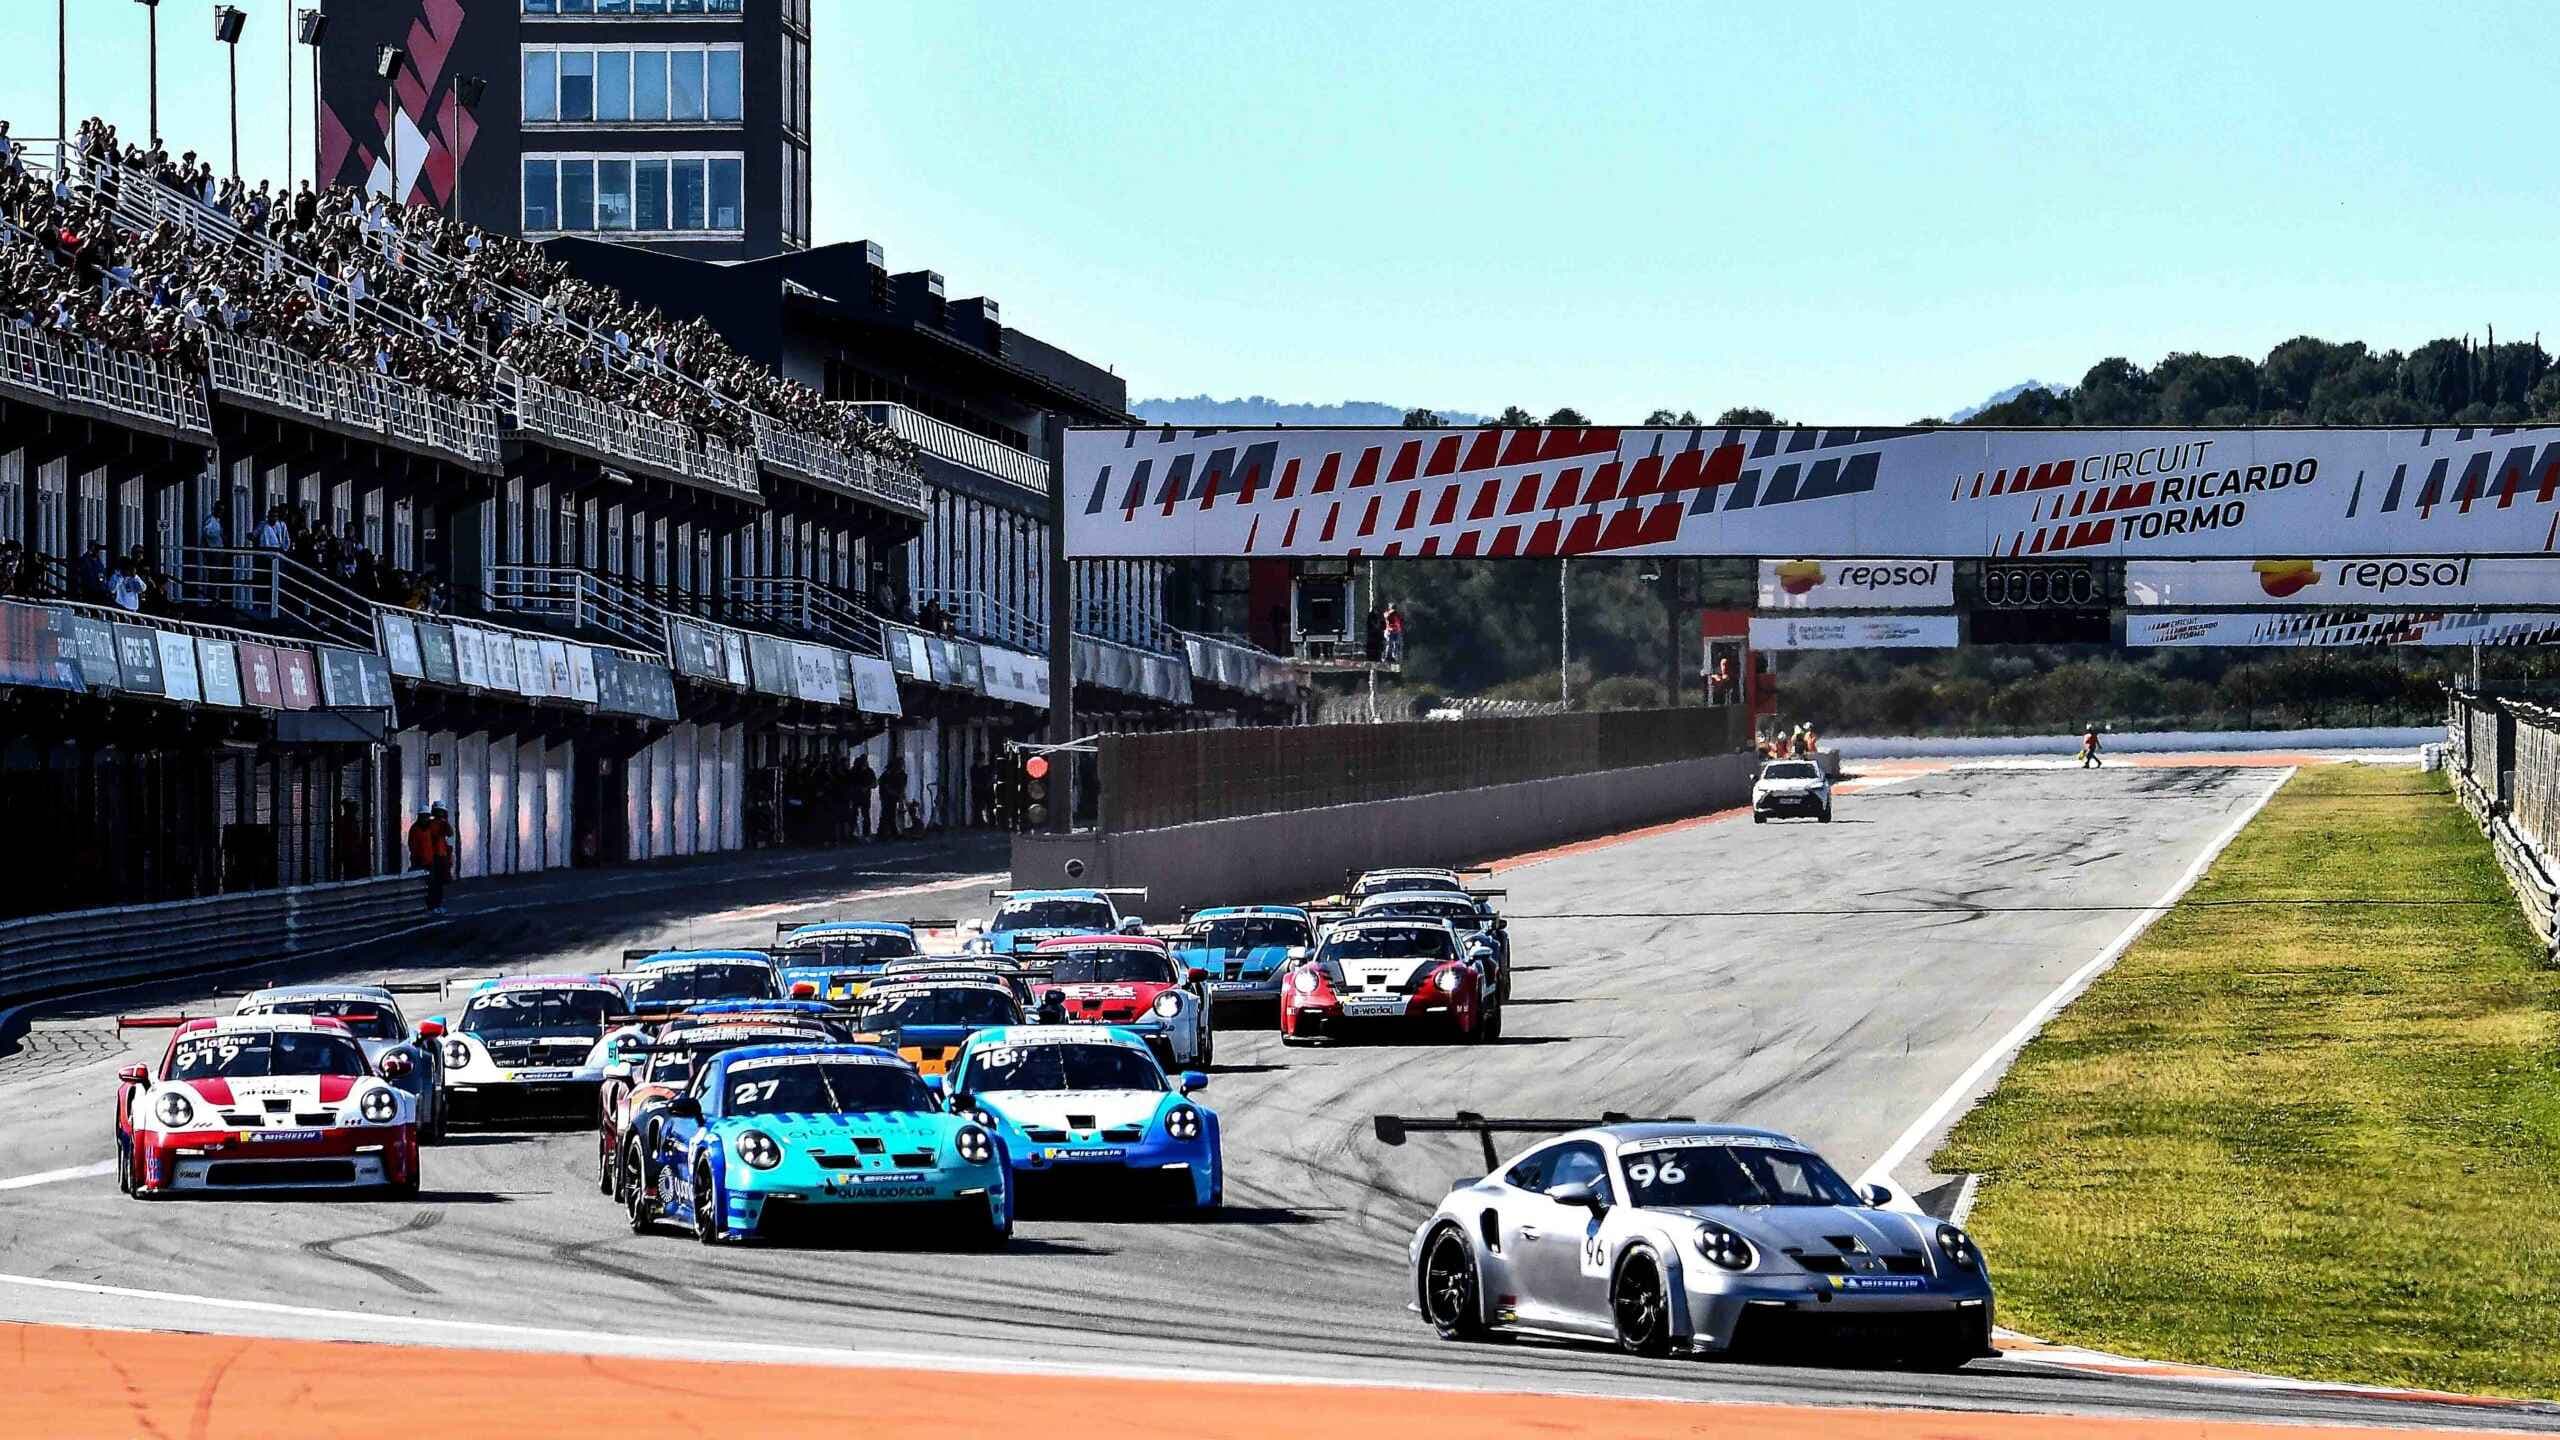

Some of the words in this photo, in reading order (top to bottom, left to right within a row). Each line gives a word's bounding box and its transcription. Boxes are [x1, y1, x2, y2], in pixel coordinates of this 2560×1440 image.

[2081, 441, 2213, 483] CIRCUIT
[2160, 457, 2319, 505] RICARDO
[2120, 500, 2246, 542] TORMO
[1839, 562, 1938, 591] repsol
[2338, 557, 2471, 593] repsol
[2171, 617, 2198, 627] CIRCUIT
[2187, 621, 2219, 631] RICARDO
[2179, 630, 2206, 640] TORMO
[1330, 930, 1360, 944] 88
[473, 993, 508, 1010] 66
[177, 1045, 239, 1071] 919
[735, 1079, 779, 1104] 27
[1070, 1149, 1121, 1157] MICHELIN
[863, 1174, 919, 1183] MICHELIN
[1629, 1161, 1686, 1188] 96
[837, 1186, 935, 1199] QUANLOOP.COM
[1586, 1239, 1604, 1266] 96
[1861, 1280, 1918, 1288] MICHELIN
